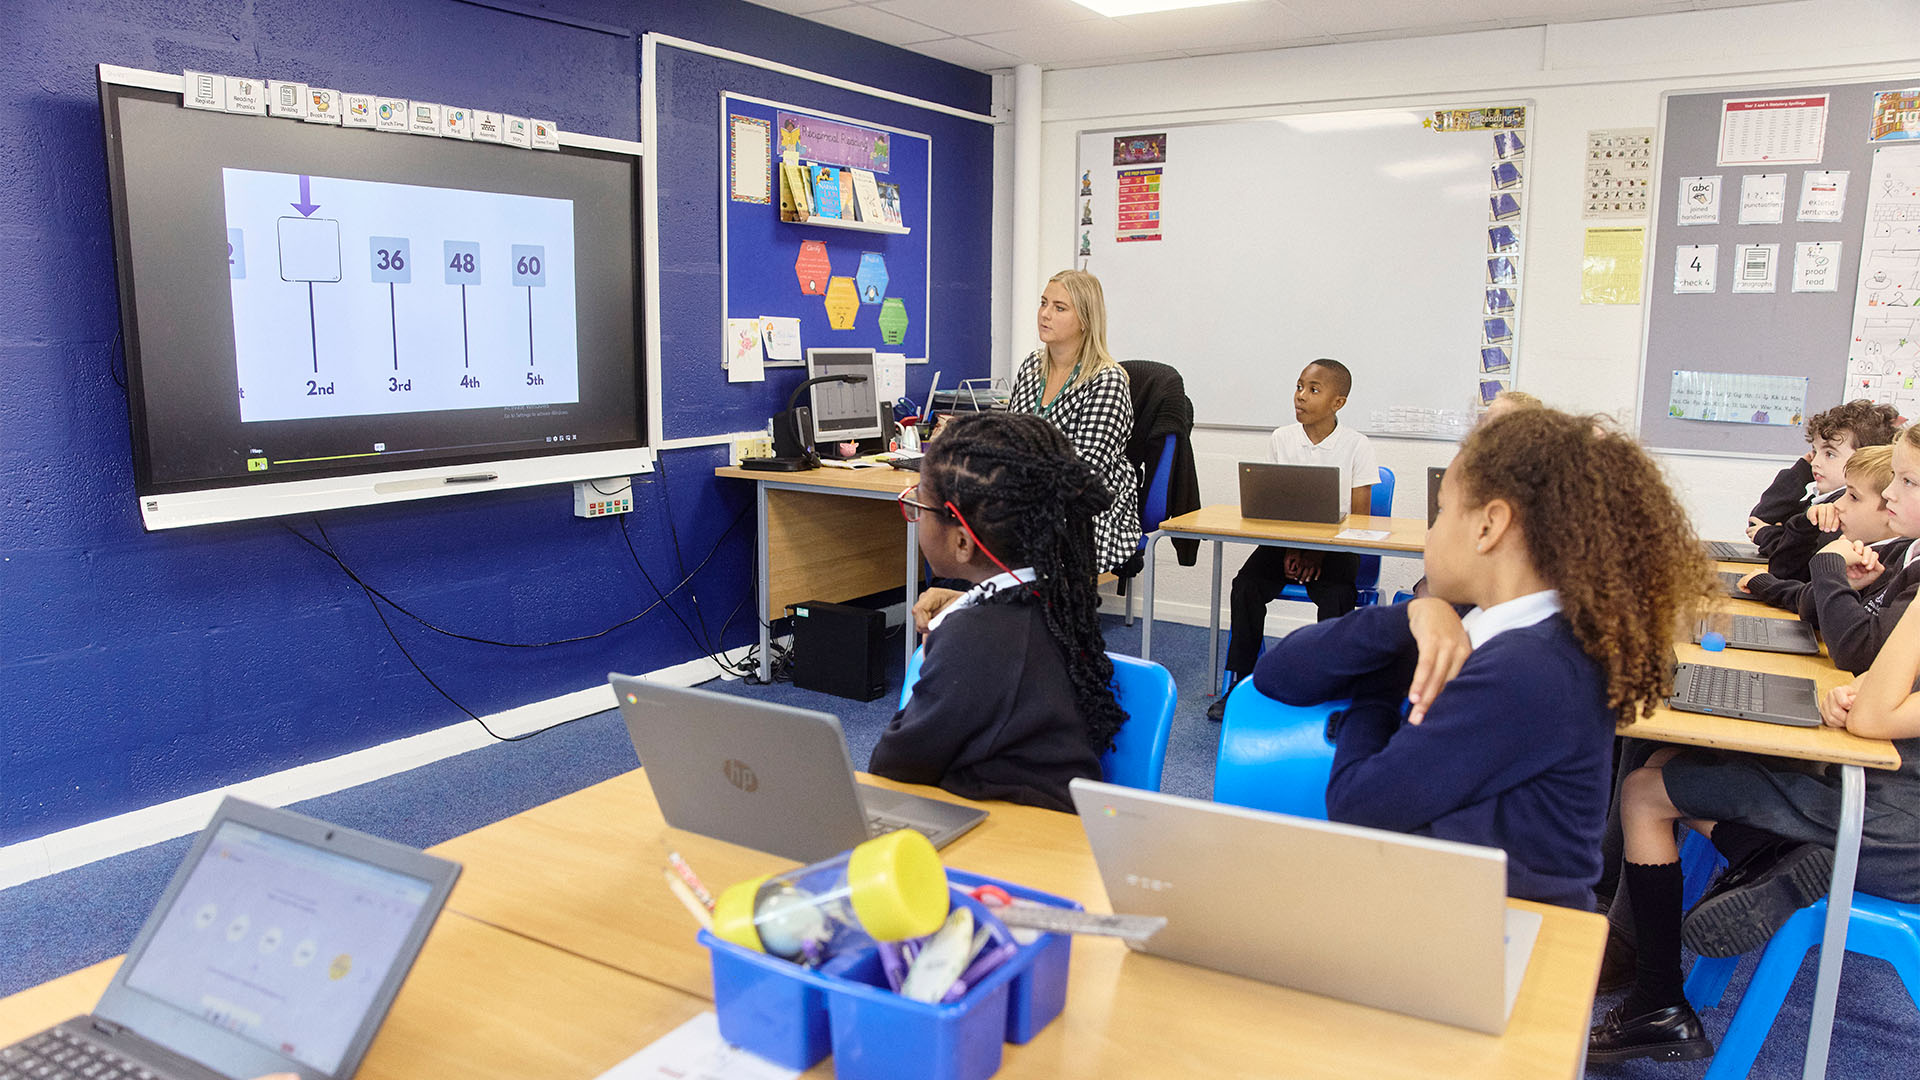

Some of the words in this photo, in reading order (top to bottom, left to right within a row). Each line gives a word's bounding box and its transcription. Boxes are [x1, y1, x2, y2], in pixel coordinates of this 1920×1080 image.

[195, 97, 215, 105] Register
[234, 96, 254, 104] Reading
[801, 124, 840, 144] Reciprocal
[841, 132, 868, 152] Reading
[1692, 183, 1710, 192] abc
[1743, 201, 1779, 209] punctuation
[1681, 213, 1717, 221] handwriting
[1801, 208, 1839, 217] sentences
[377, 249, 405, 271] 36
[449, 253, 475, 273] 48
[517, 256, 541, 276] 60
[1690, 255, 1702, 273] 4
[1805, 268, 1827, 276] proof
[1805, 278, 1824, 286] read
[388, 377, 412, 392] 3rd
[460, 375, 480, 388] 4th
[526, 372, 544, 386] 5th
[306, 380, 335, 396] 2nd
[730, 760, 753, 792] hp
